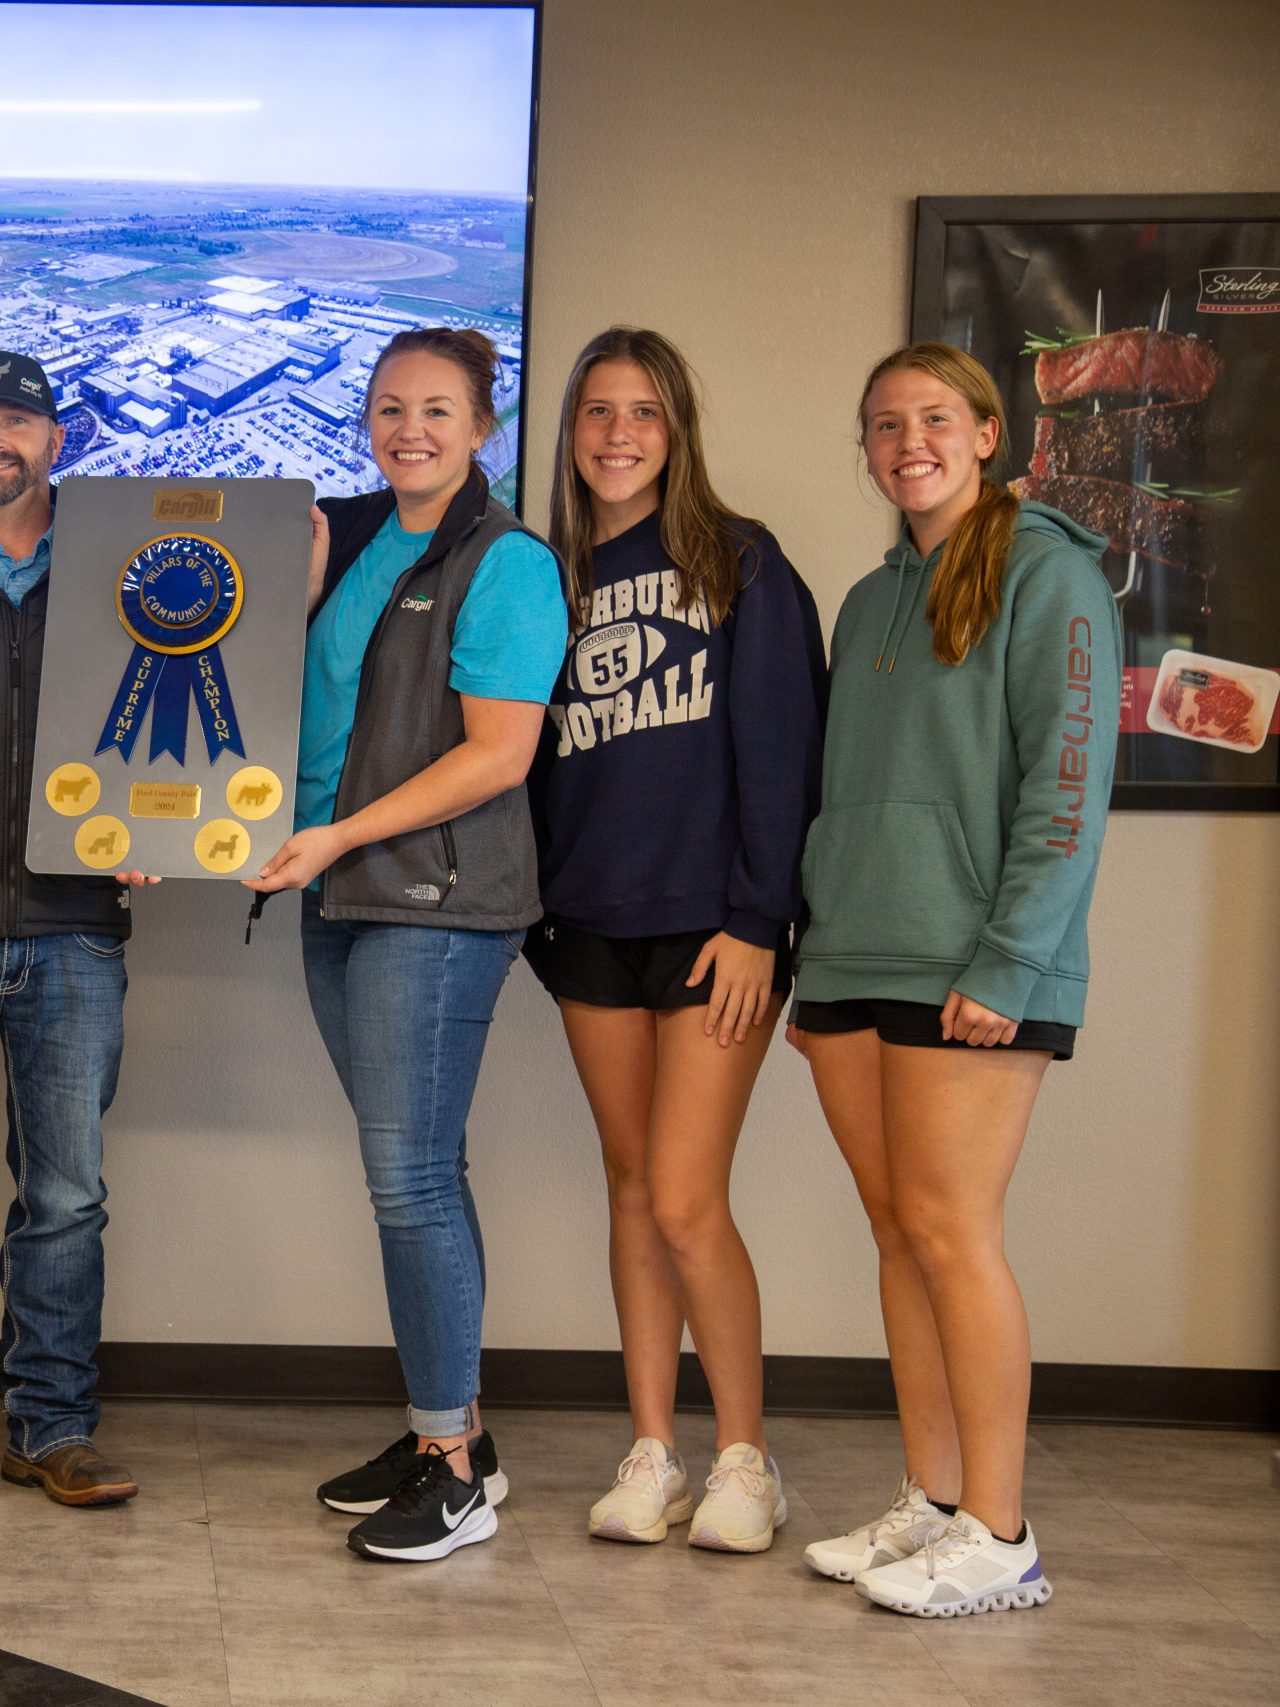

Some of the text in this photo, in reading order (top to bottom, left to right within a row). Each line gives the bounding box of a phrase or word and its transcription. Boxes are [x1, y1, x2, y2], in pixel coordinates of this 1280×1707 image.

[1205, 271, 1280, 299] Sterling
[146, 556, 213, 588] PILLARS OF THE
[145, 595, 207, 621] COMMUNITY
[401, 597, 433, 611] Cargill
[591, 643, 629, 688] 55
[113, 656, 153, 742] SUPREME
[198, 655, 230, 742] CHAMPION
[1045, 616, 1094, 860] carhartt
[136, 789, 153, 797] Ford
[155, 790, 179, 798] County
